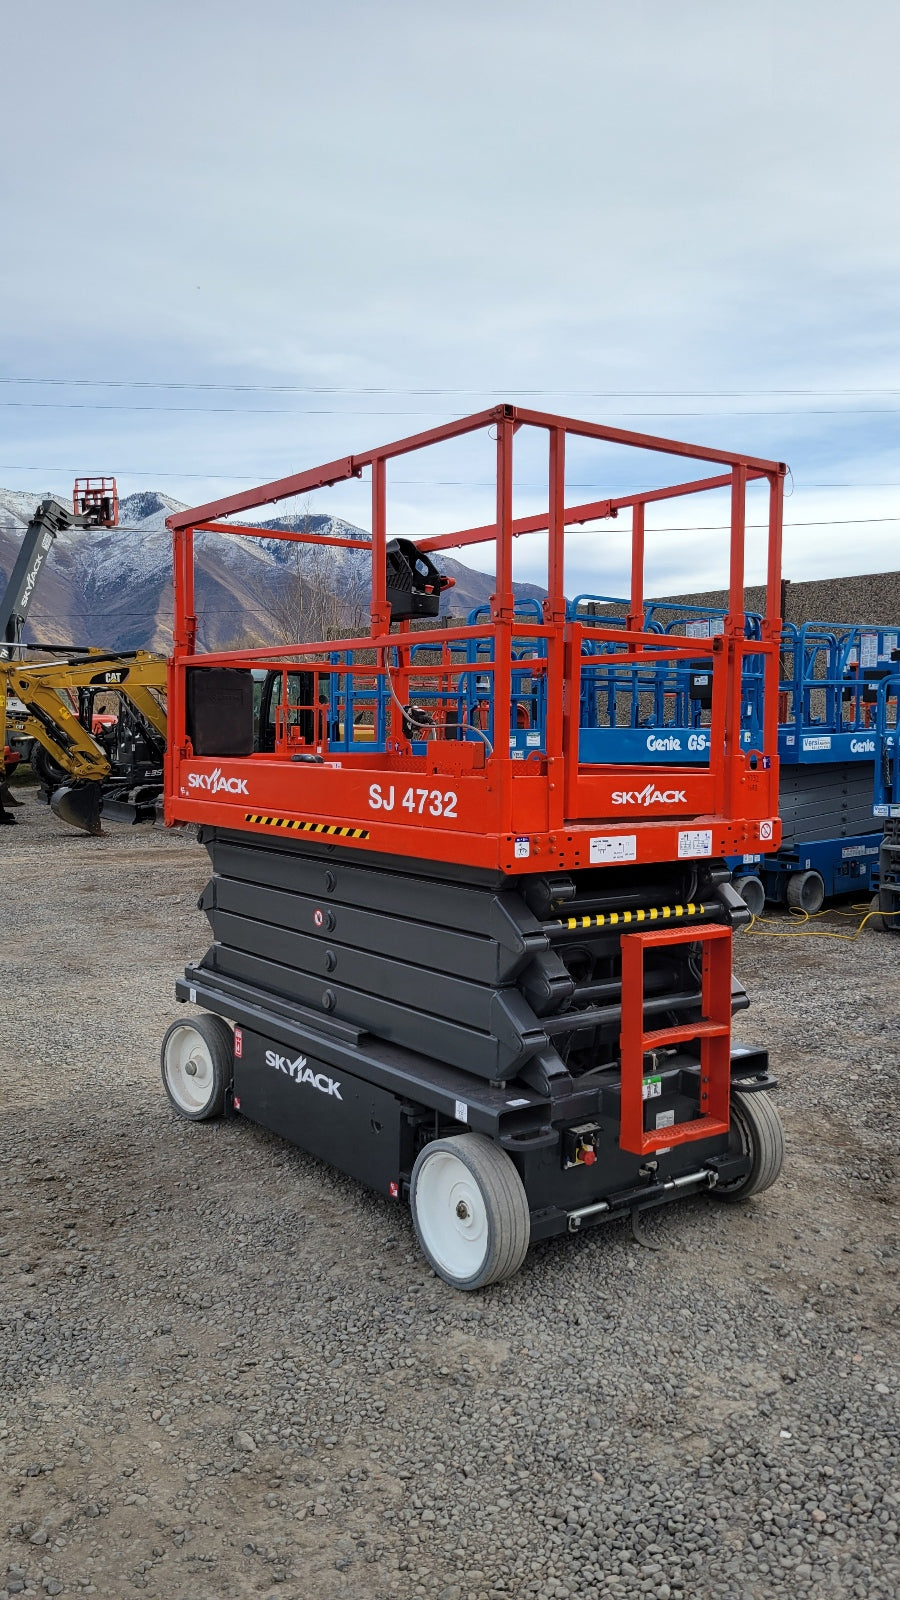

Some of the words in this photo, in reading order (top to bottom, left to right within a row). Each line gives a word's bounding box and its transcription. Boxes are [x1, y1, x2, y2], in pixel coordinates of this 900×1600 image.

[21, 553, 45, 609] SKYJACK
[105, 672, 122, 684] CAT
[646, 733, 682, 752] Genie
[850, 738, 876, 754] Genie
[187, 767, 250, 796] SKYJACK
[368, 784, 395, 811] SJ
[402, 788, 458, 818] 4732
[611, 783, 688, 807] SKYJACK
[264, 1049, 344, 1102] SKYJACK
